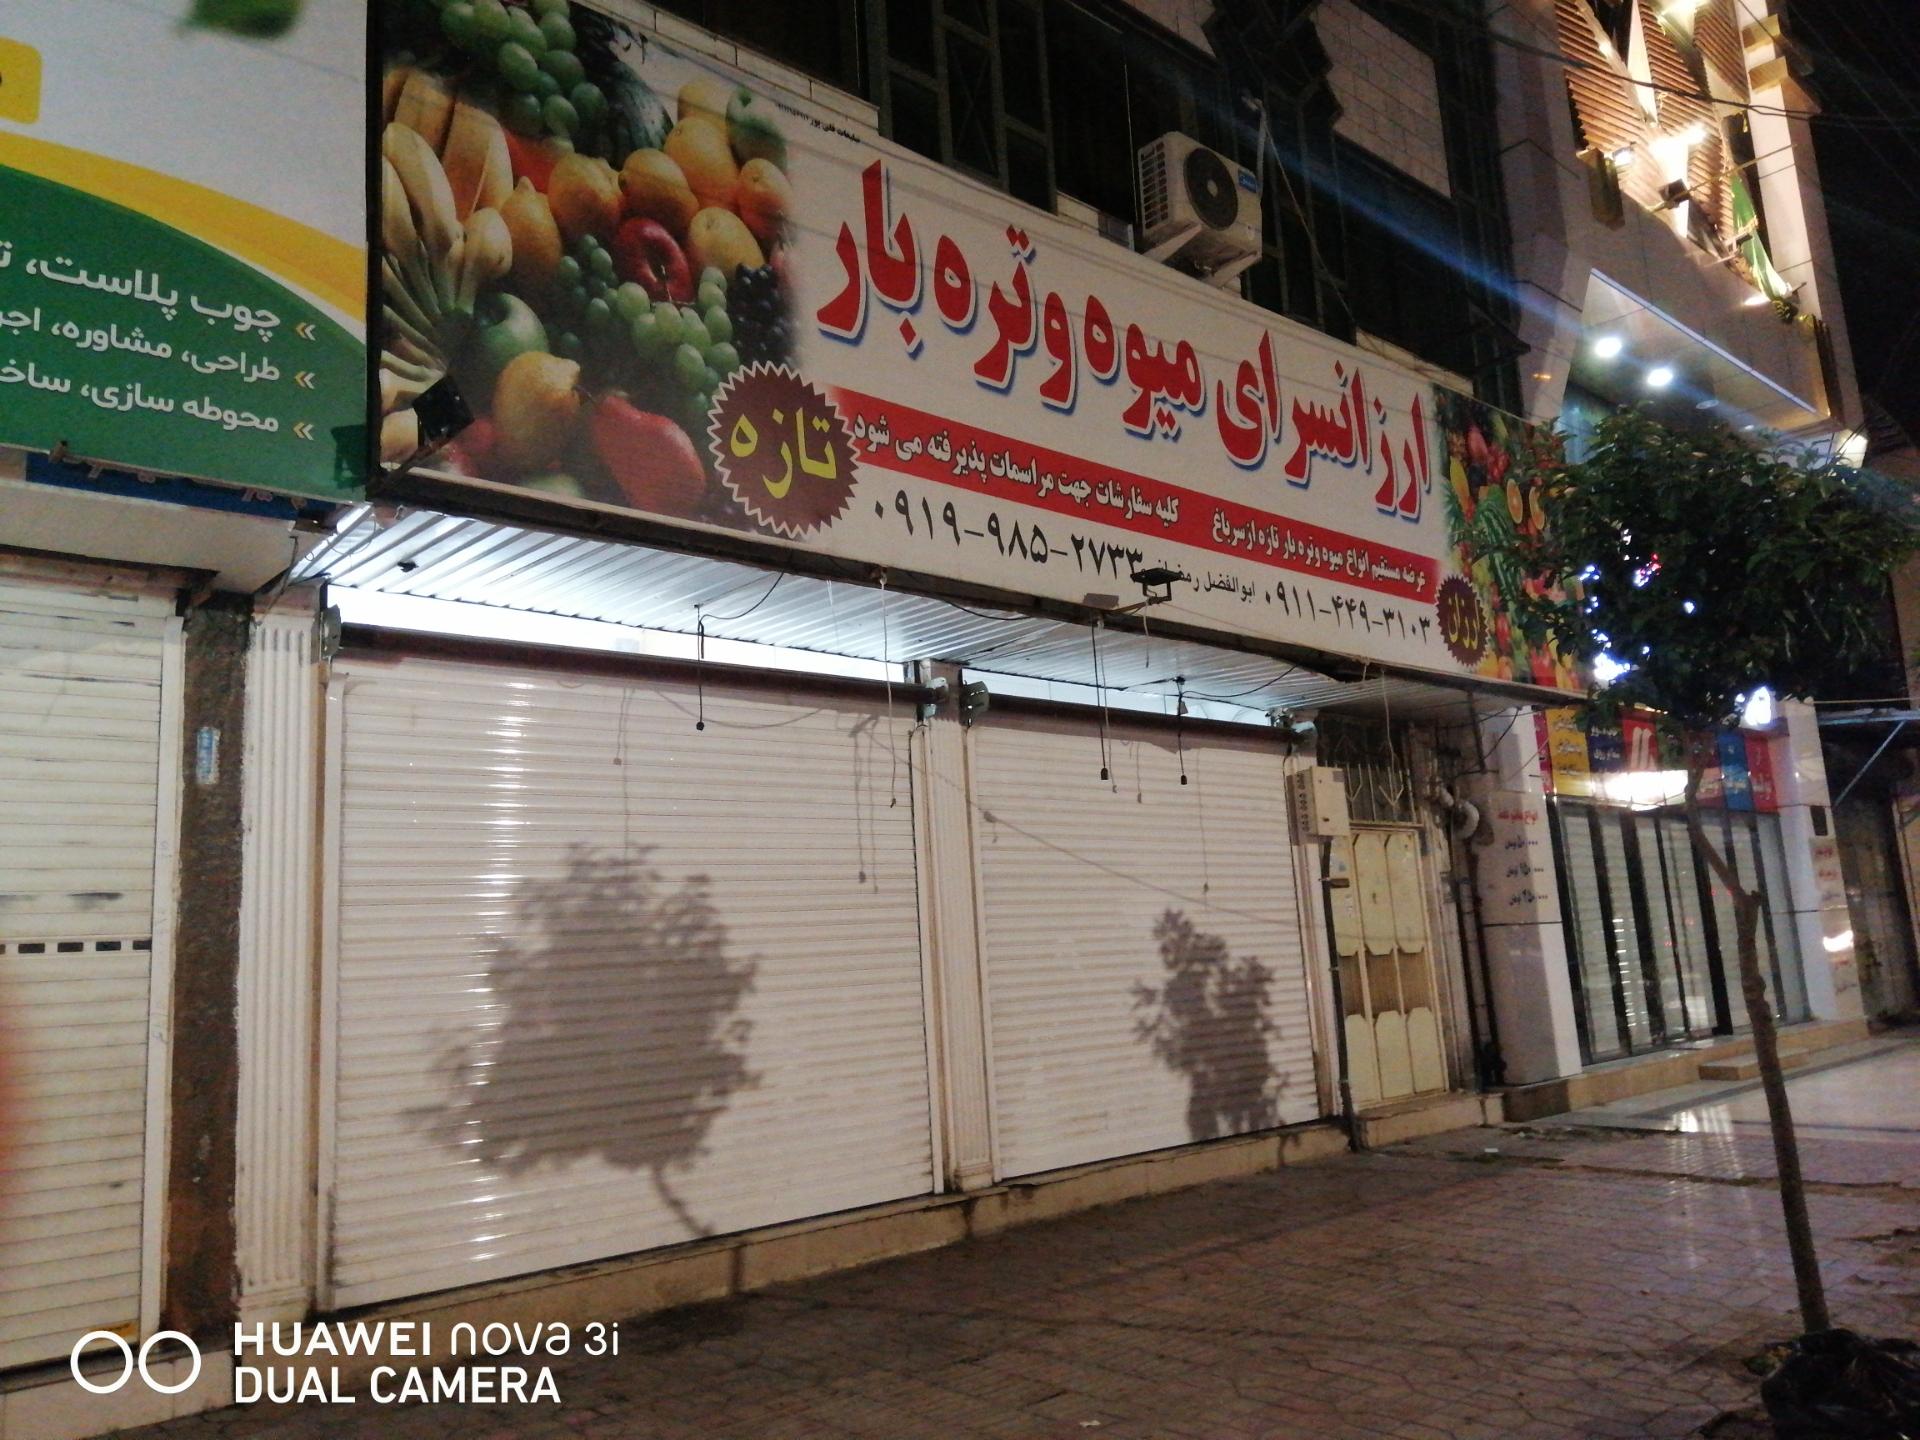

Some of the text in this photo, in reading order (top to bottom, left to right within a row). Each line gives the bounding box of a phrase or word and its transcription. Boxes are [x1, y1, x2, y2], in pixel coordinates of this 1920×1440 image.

[190, 294, 281, 343] چوب
[0, 359, 71, 393] ساخ
[1083, 294, 1207, 440] میوه
[182, 397, 280, 432] محوطه
[730, 406, 837, 499] تازه
[989, 450, 1055, 497] مراسمات
[1057, 470, 1092, 508] جهت
[1095, 480, 1153, 519] سفارشات
[1155, 495, 1180, 527] کلیه
[1258, 523, 1279, 556] تازه
[1346, 547, 1370, 578] انواع
[1371, 555, 1401, 581] مستقیم
[1448, 591, 1480, 651] ارزان
